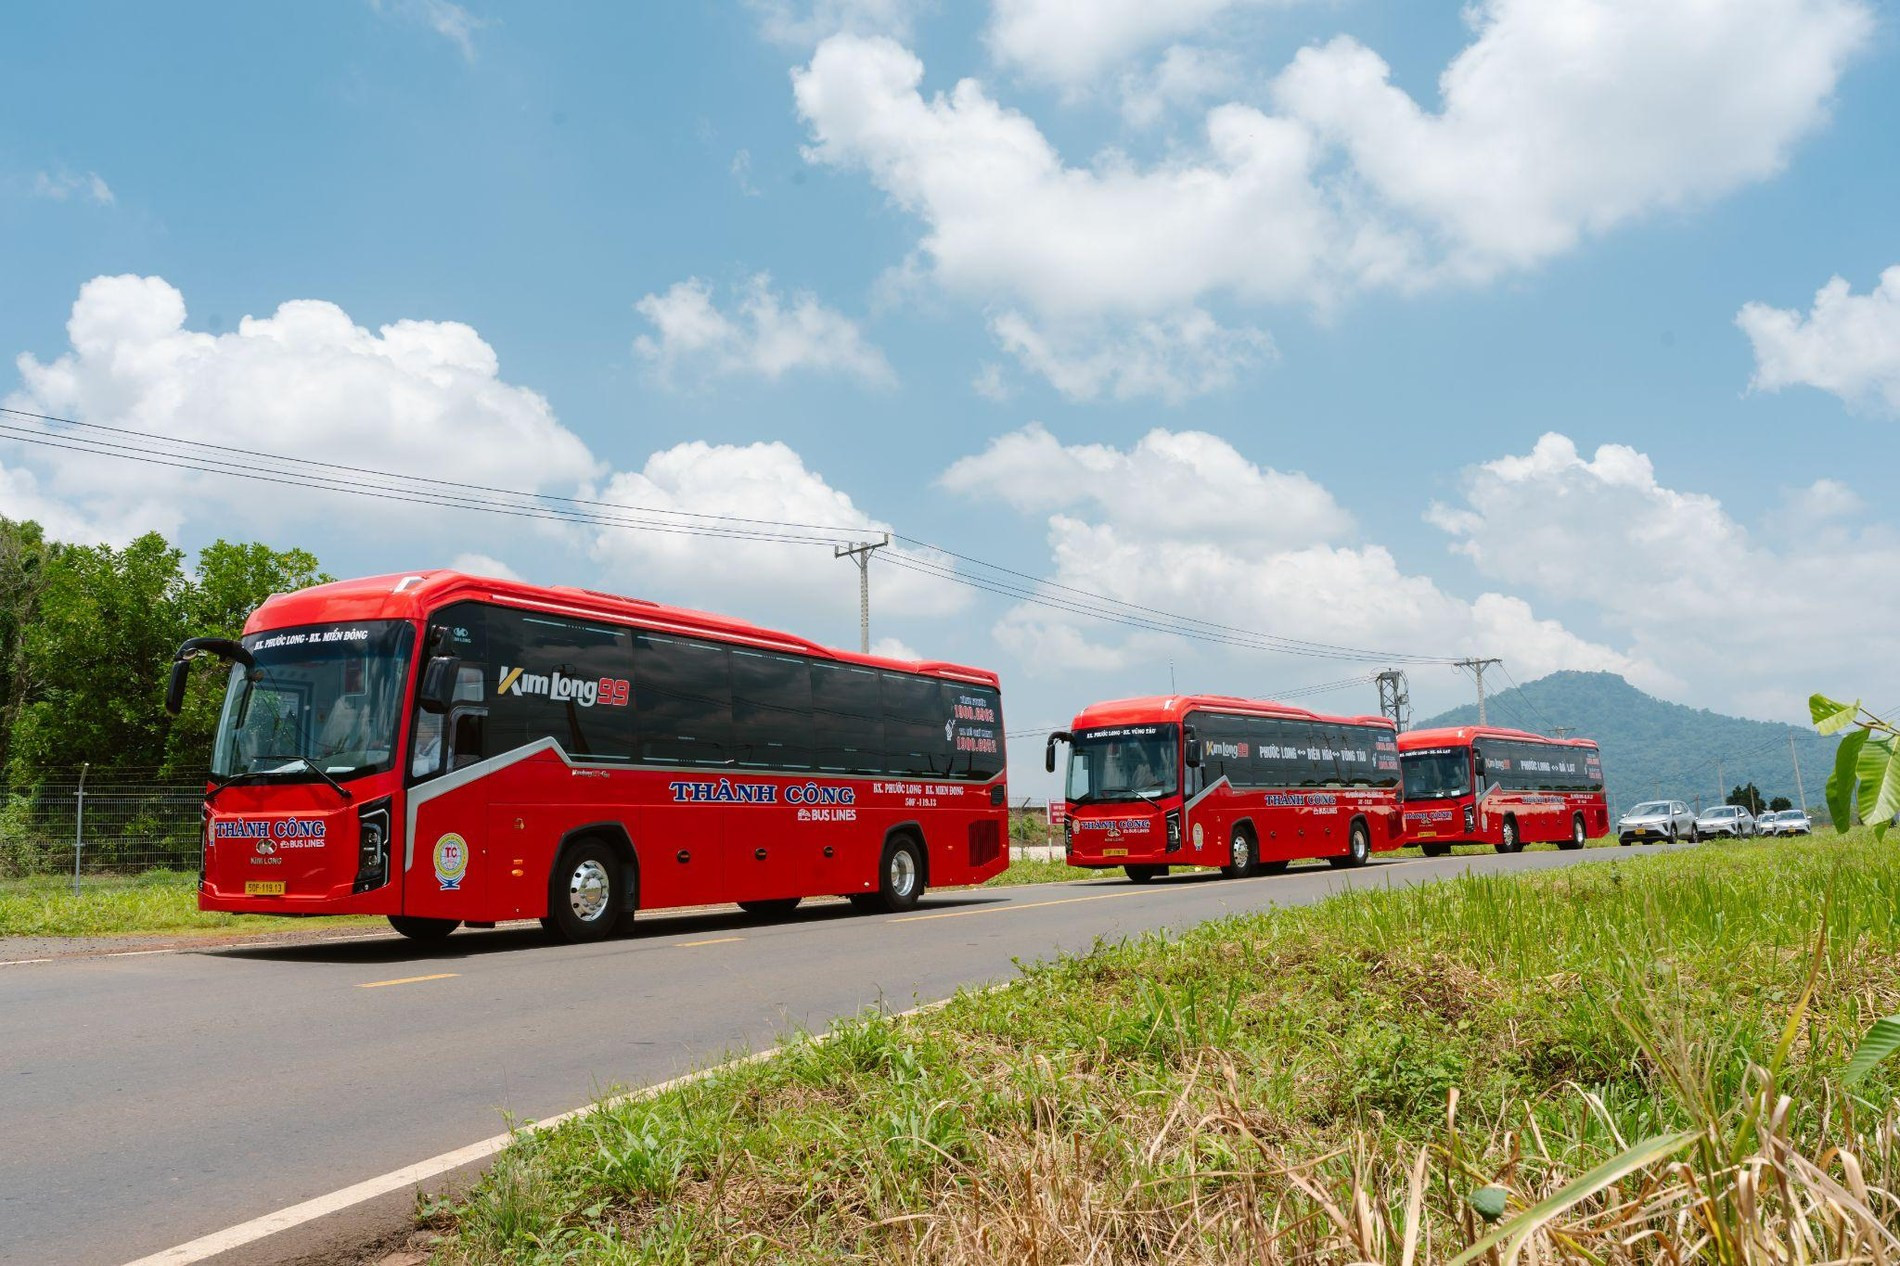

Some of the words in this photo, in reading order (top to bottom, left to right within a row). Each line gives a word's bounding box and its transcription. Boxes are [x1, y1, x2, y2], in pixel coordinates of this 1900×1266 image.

[286, 634, 305, 645] LONG
[309, 632, 322, 643] BX.
[1280, 746, 1298, 759] LONG
[669, 778, 777, 804] THÀNH
[785, 782, 856, 805] CÔNG
[906, 784, 922, 794] LONG
[1264, 791, 1305, 806] THÀNH
[1307, 792, 1336, 805] CÔNG
[812, 809, 830, 821] BUS
[831, 809, 857, 821] LINES
[215, 817, 271, 838] THÀNH
[274, 816, 326, 838] CÔNG
[1081, 819, 1116, 829] THÀNH
[1119, 818, 1150, 829] CÔNG
[290, 839, 304, 848] BUS
[304, 839, 325, 848] LINES
[445, 847, 457, 858] TC
[264, 857, 282, 865] LONG
